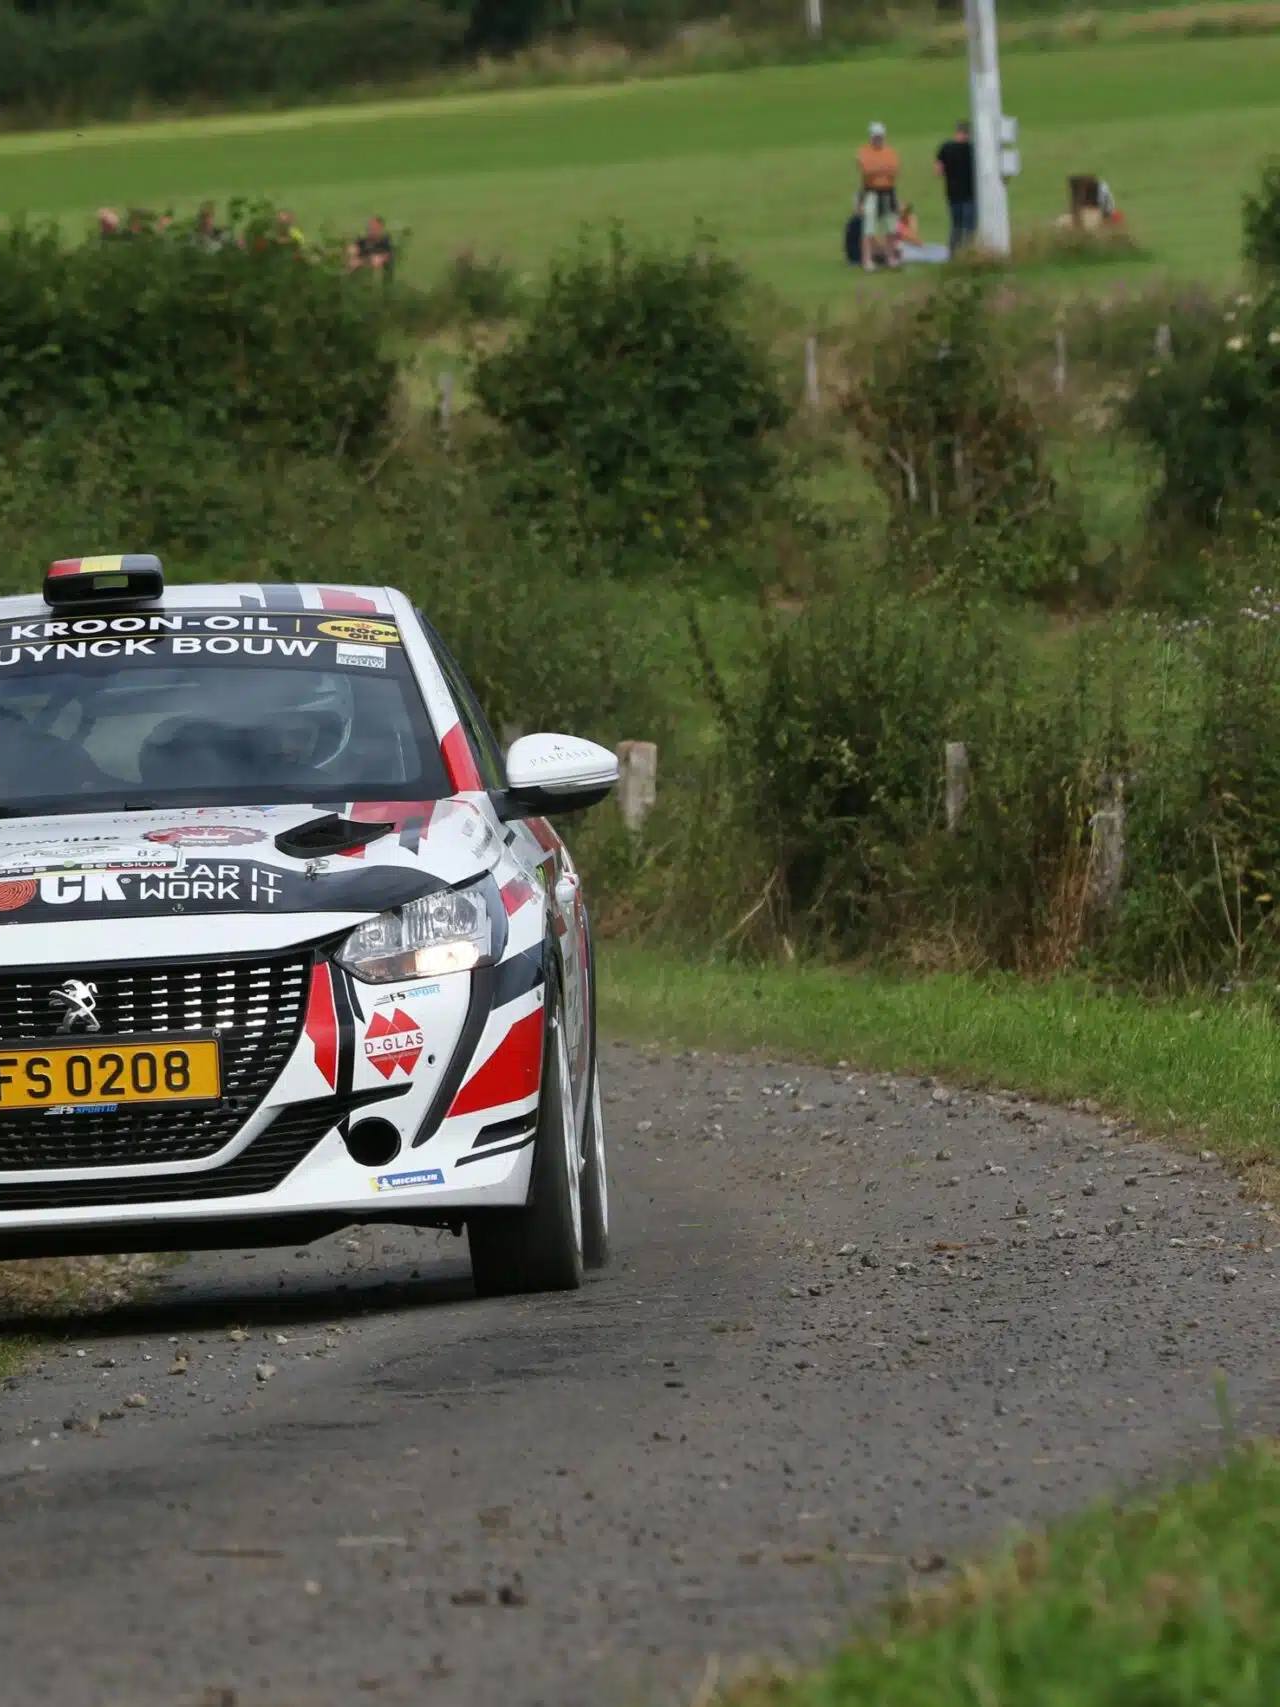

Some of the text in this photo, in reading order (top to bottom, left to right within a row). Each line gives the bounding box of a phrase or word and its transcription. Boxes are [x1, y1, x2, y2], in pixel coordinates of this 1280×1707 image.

[10, 615, 278, 640] KROON-OIL
[331, 625, 398, 638] KROON
[349, 633, 379, 641] OIL
[172, 638, 319, 658] BOUW
[80, 861, 167, 870] BELGIUM
[251, 868, 283, 887] IT
[140, 881, 283, 904] WORK IT
[364, 1031, 424, 1055] D-GLAS
[66, 1050, 190, 1098] 0208
[391, 1172, 439, 1186] MICHELIN
